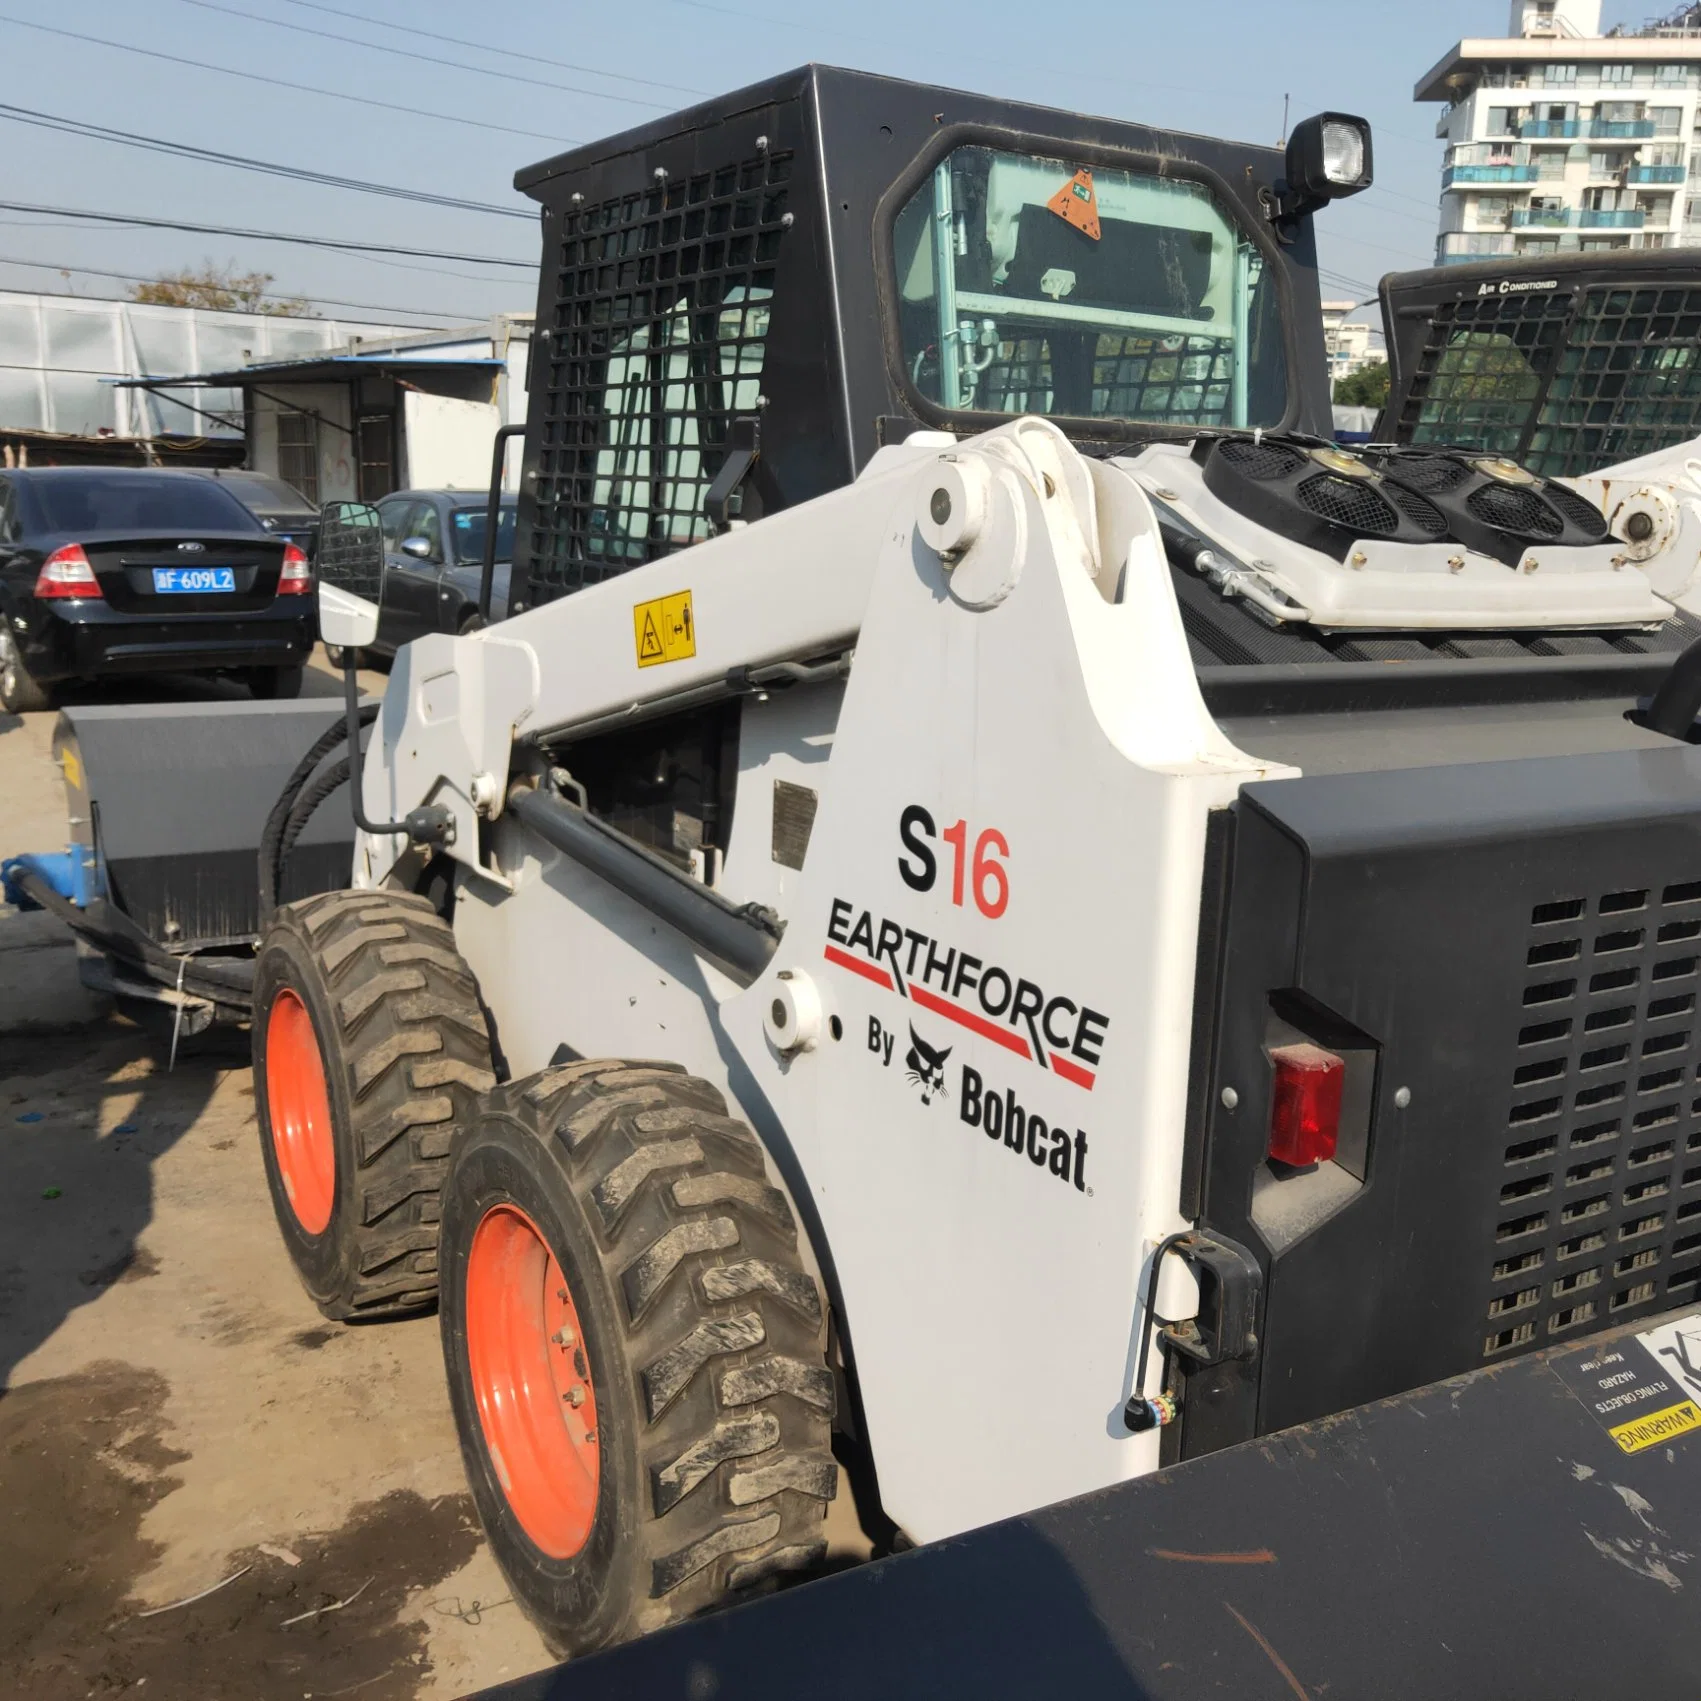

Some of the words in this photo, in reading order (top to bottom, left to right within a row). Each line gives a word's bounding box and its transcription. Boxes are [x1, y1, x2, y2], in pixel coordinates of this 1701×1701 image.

[898, 804, 1009, 920] S16
[827, 898, 1110, 1069] EARTHFORCE
[867, 1015, 894, 1067] By
[960, 1065, 1088, 1193] Bobcat
[1598, 1370, 1637, 1389] HAZARD
[1635, 1381, 1669, 1399] FLYING
[1595, 1392, 1637, 1413] OBJECTS
[1617, 1413, 1688, 1447] WARNING
